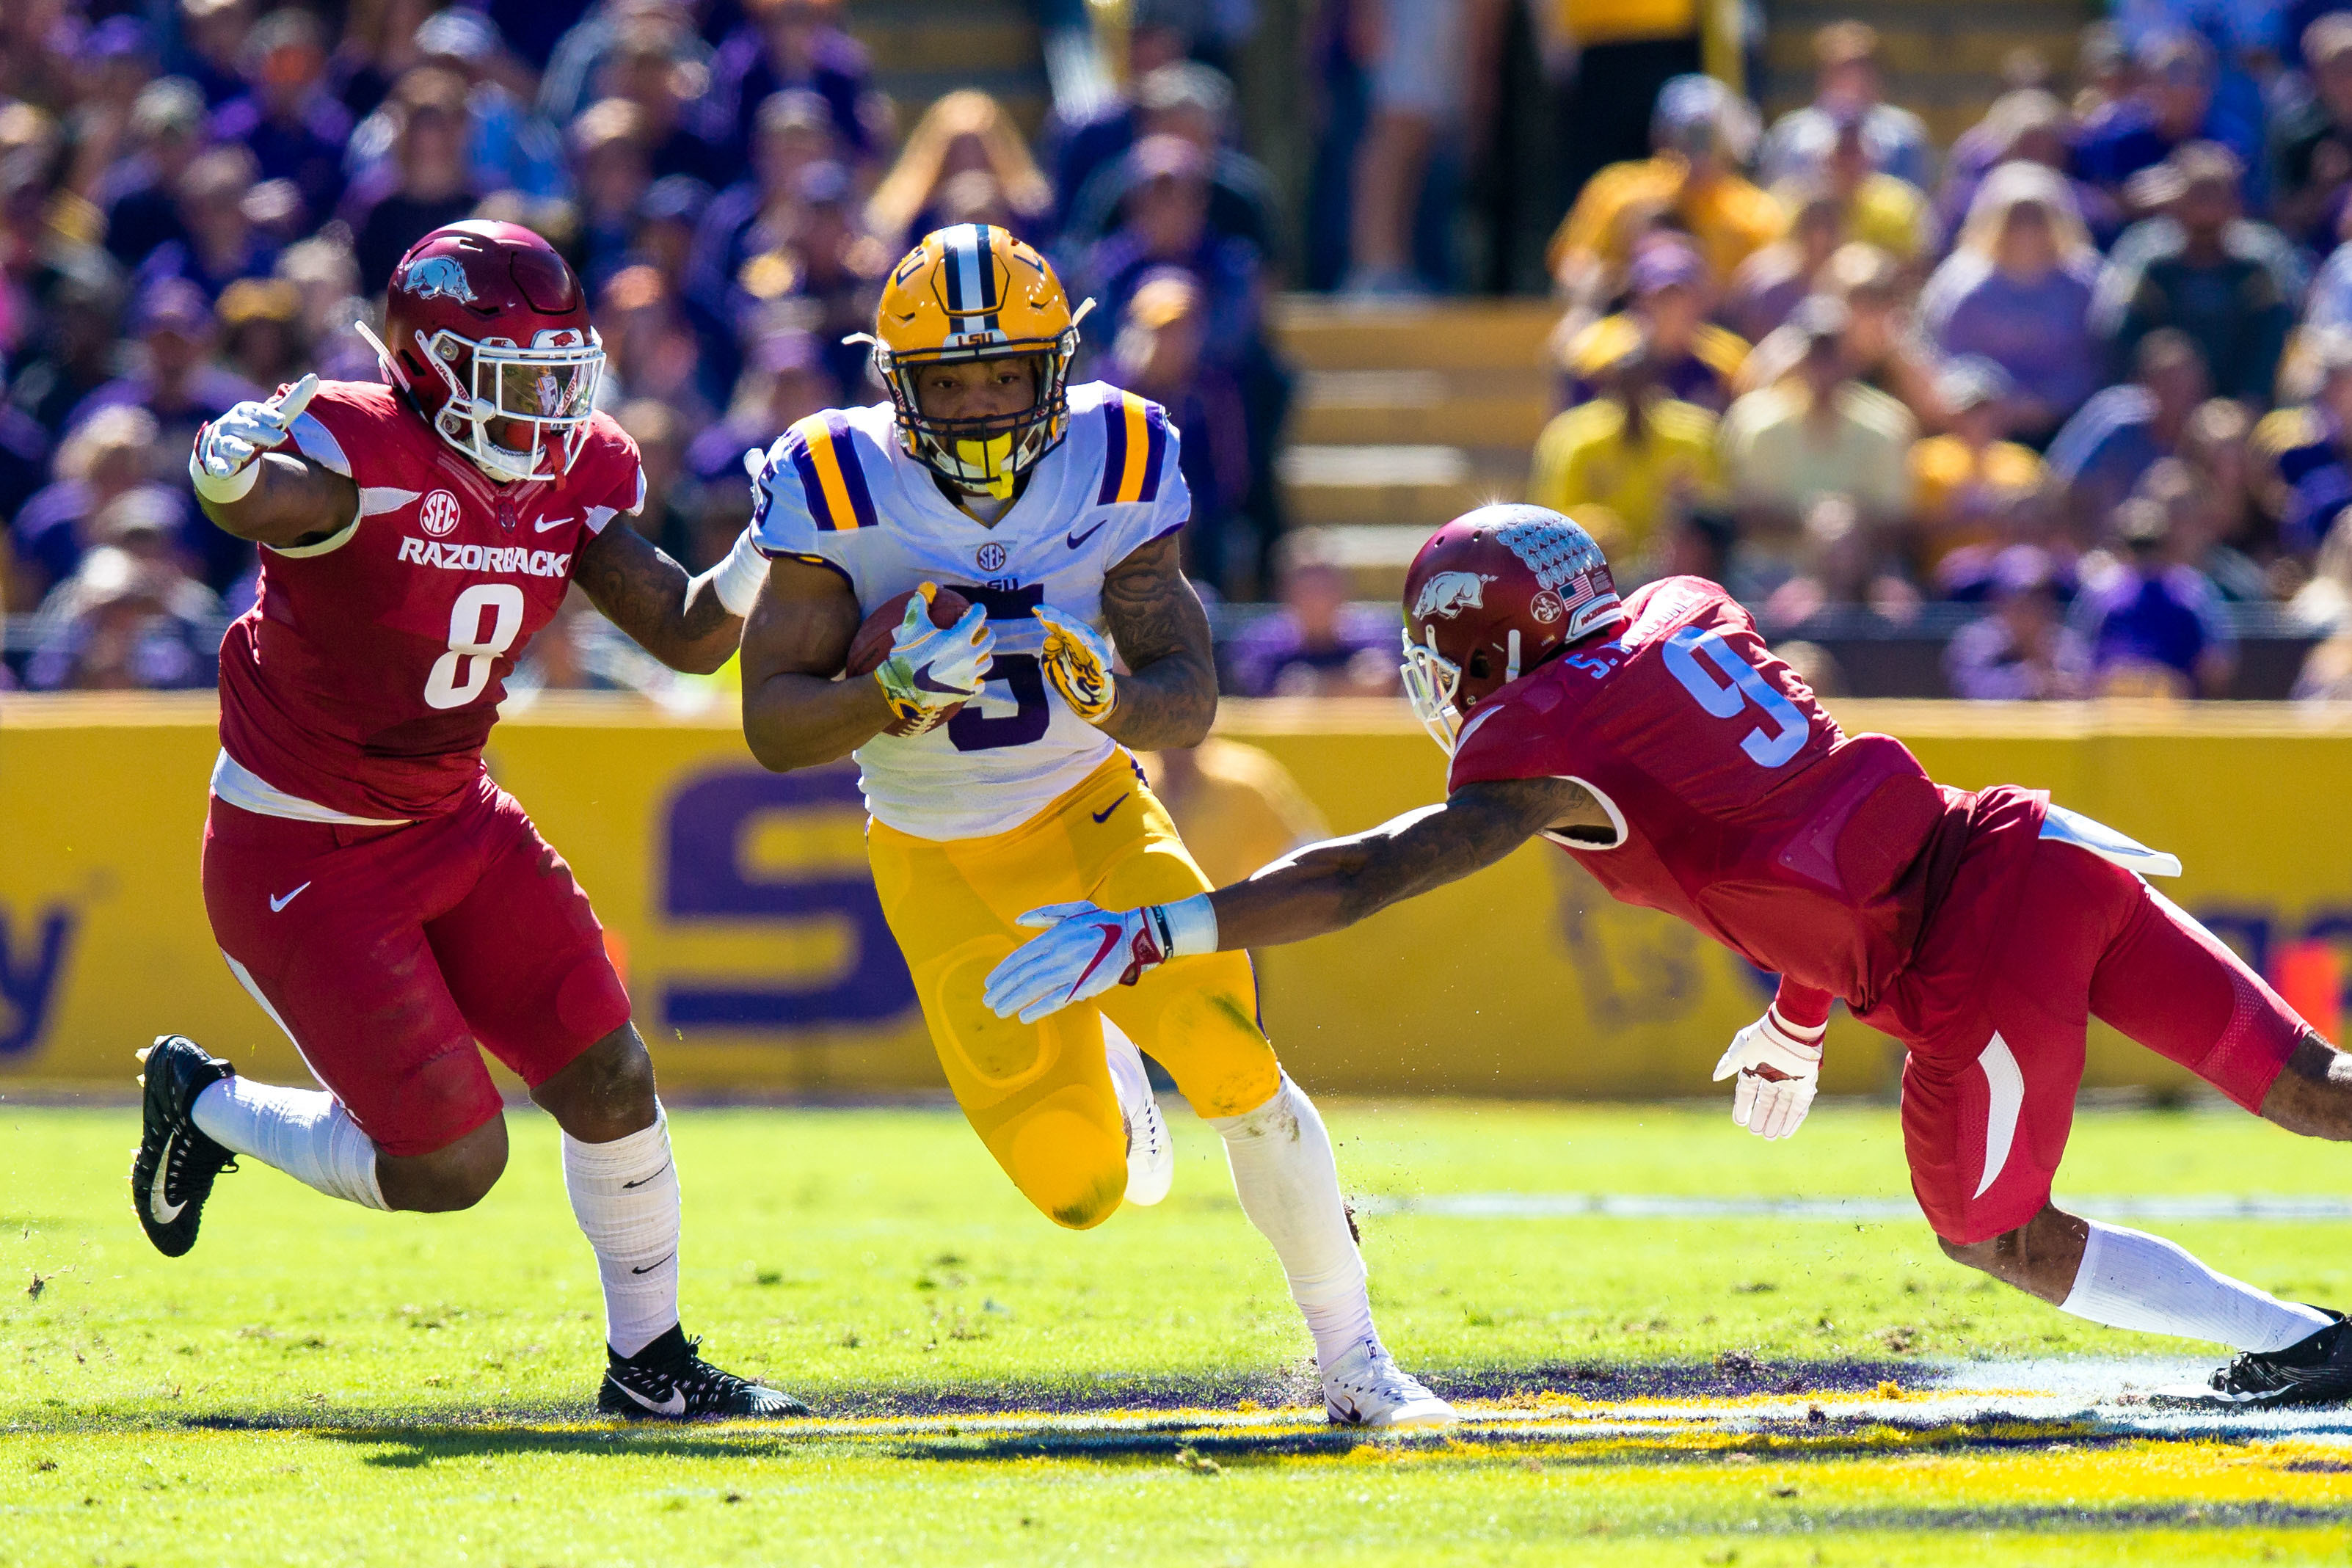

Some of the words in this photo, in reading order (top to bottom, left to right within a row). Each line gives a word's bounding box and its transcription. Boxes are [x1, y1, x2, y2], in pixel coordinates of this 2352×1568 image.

[957, 332, 993, 346] LSU
[423, 493, 456, 533] SEC
[398, 536, 571, 577] RAZORBACK
[979, 544, 1005, 569] SEC
[986, 577, 1019, 591] SU
[423, 583, 524, 710] 8
[943, 583, 1049, 751] 5
[1662, 625, 1810, 768] 9
